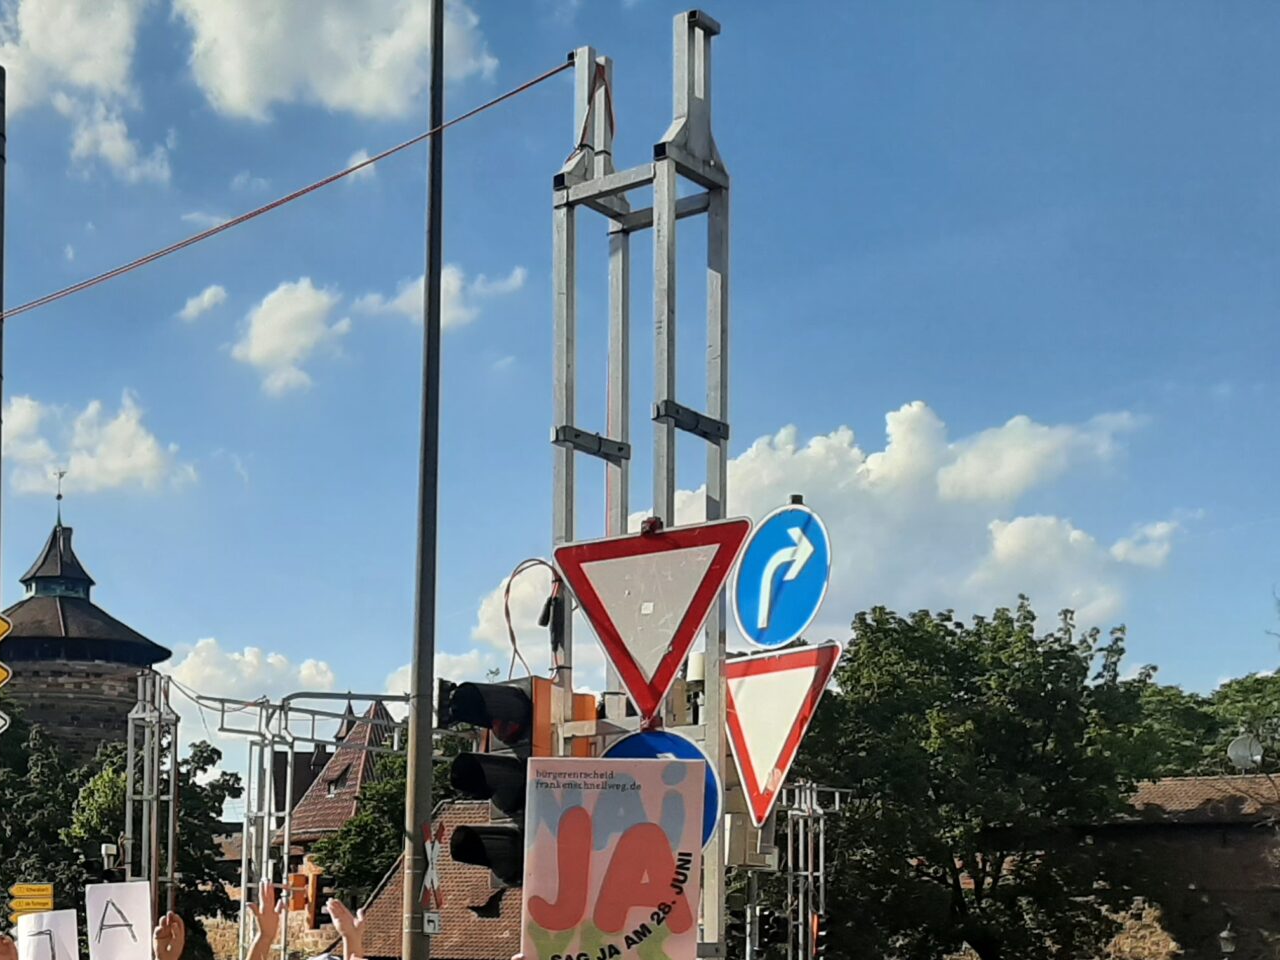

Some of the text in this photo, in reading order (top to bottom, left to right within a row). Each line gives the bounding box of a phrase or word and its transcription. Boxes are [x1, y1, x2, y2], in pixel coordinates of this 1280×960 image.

[535, 769, 614, 780] bürgerentscheid
[535, 779, 642, 793] frankenschnellweg.de
[527, 805, 694, 935] JA
[95, 898, 138, 944] A
[624, 922, 652, 949] AM
[670, 851, 693, 895] JUNI
